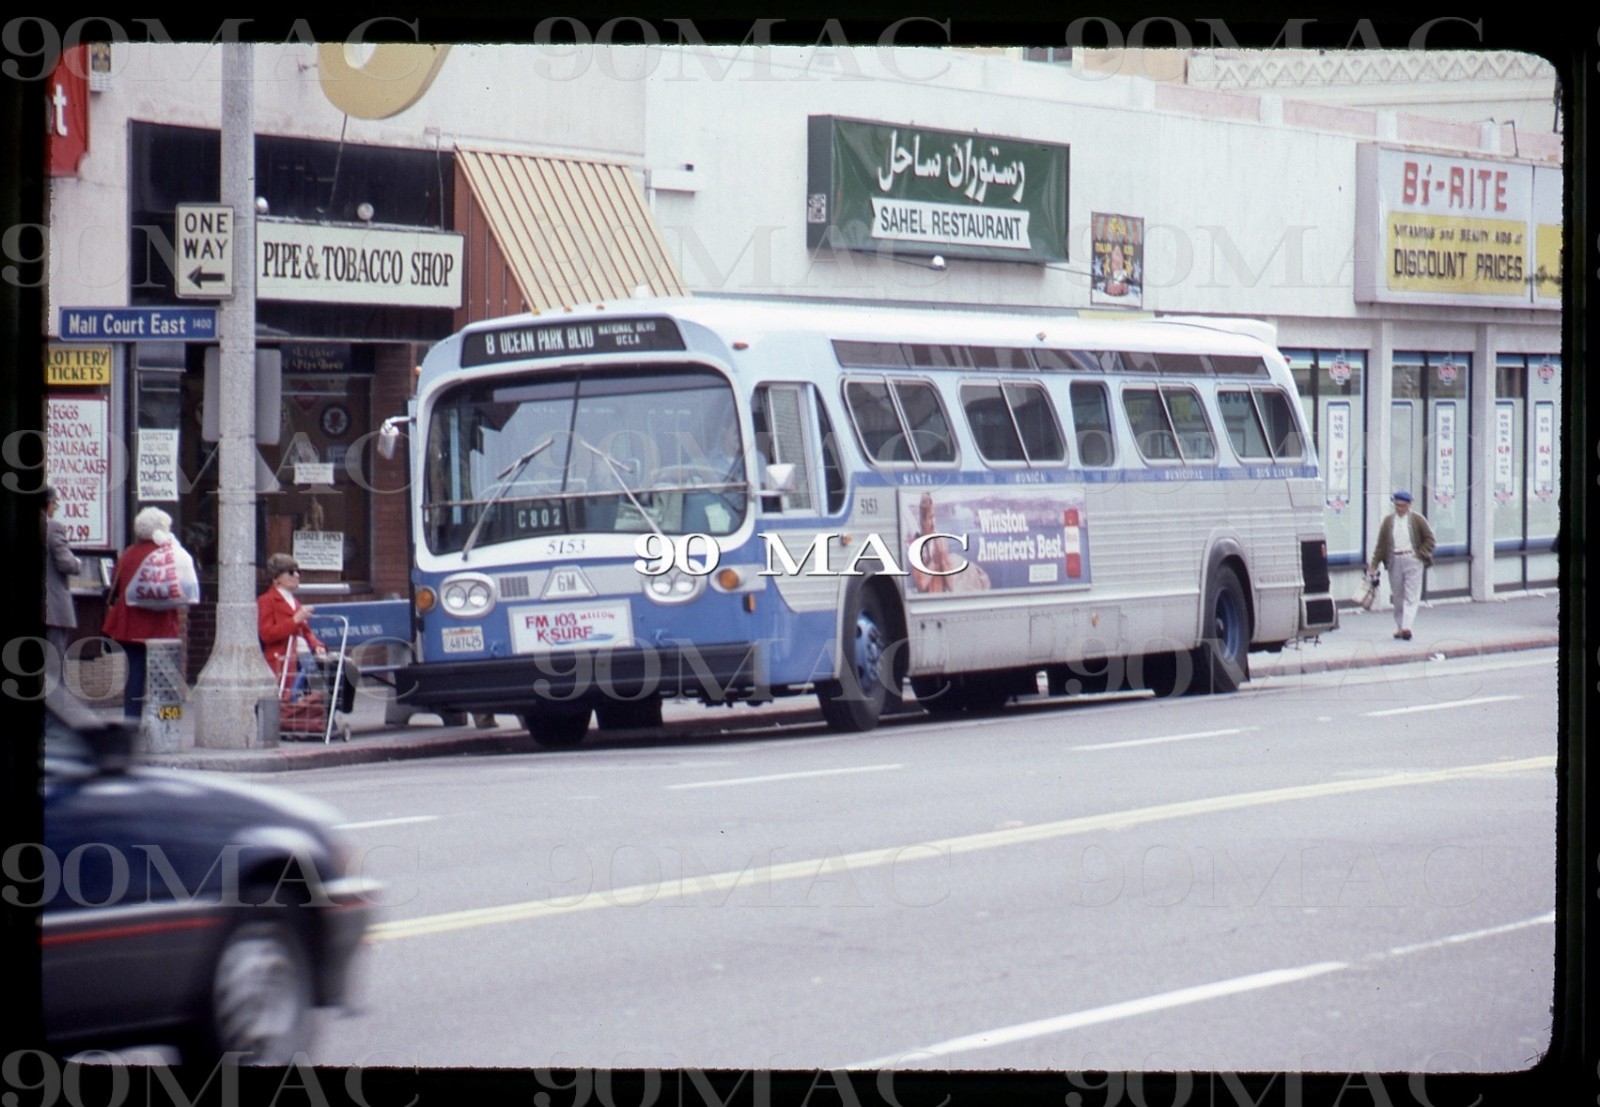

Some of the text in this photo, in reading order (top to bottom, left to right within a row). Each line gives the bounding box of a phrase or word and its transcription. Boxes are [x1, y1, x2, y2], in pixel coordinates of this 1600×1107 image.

[878, 130, 1025, 203] رستوران ساحل
[184, 213, 228, 234] ONE
[881, 206, 1021, 241] SAHEL RESTAURANT
[184, 239, 228, 260] WAY
[262, 242, 454, 287] PIPE & TOBACCO SHOP
[1394, 248, 1523, 281] DISCOUNT PRICES
[69, 313, 212, 335] Mall Court East 1400
[486, 326, 594, 355] 8 OCEAN PARK BLVD
[616, 335, 640, 345] UCLA
[52, 367, 103, 380] TICKETS
[53, 404, 79, 420] EGGS
[53, 422, 92, 438] BACON
[54, 440, 99, 457] SAUSAGE
[53, 459, 106, 474] PANCAKES
[903, 474, 932, 484] SANTA
[64, 503, 89, 517] JUICE
[861, 499, 877, 514] 5153
[547, 539, 585, 555] 5153
[977, 535, 1035, 562] America's
[139, 567, 177, 583] SALE
[135, 583, 180, 600] SALE
[526, 615, 548, 629] FM
[554, 612, 576, 627] 103
